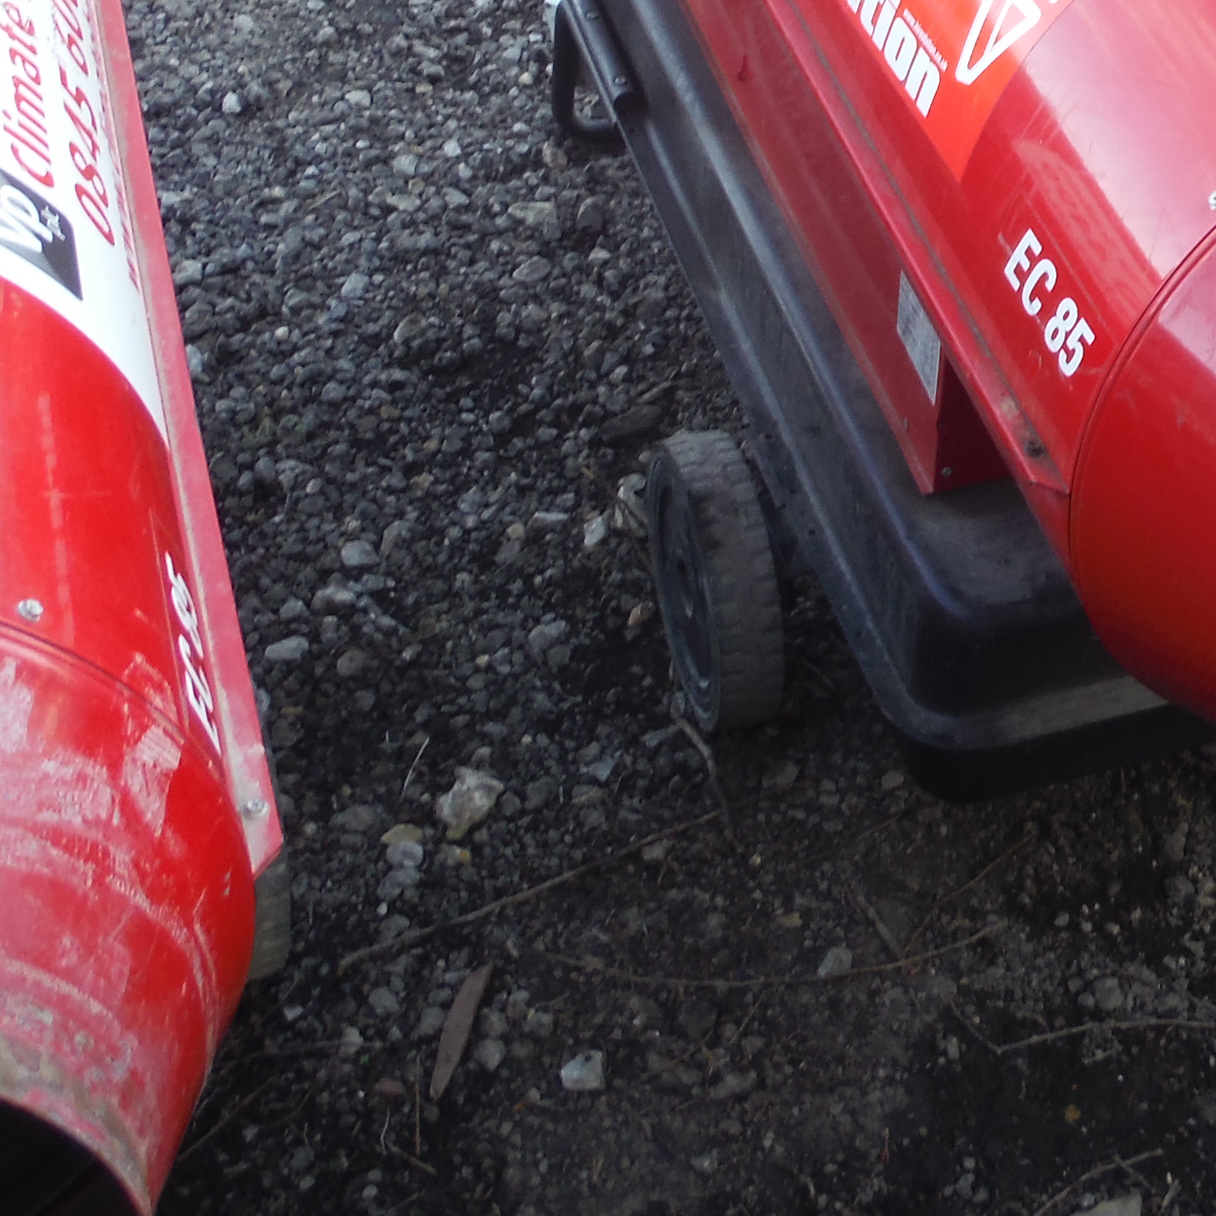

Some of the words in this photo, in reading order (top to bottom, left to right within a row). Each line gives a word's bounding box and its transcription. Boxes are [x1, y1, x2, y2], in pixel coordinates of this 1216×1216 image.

[0, 1, 55, 188] Climate
[58, 63, 116, 247] 0845
[1004, 227, 1057, 316] EC
[1044, 297, 1096, 377] 85
